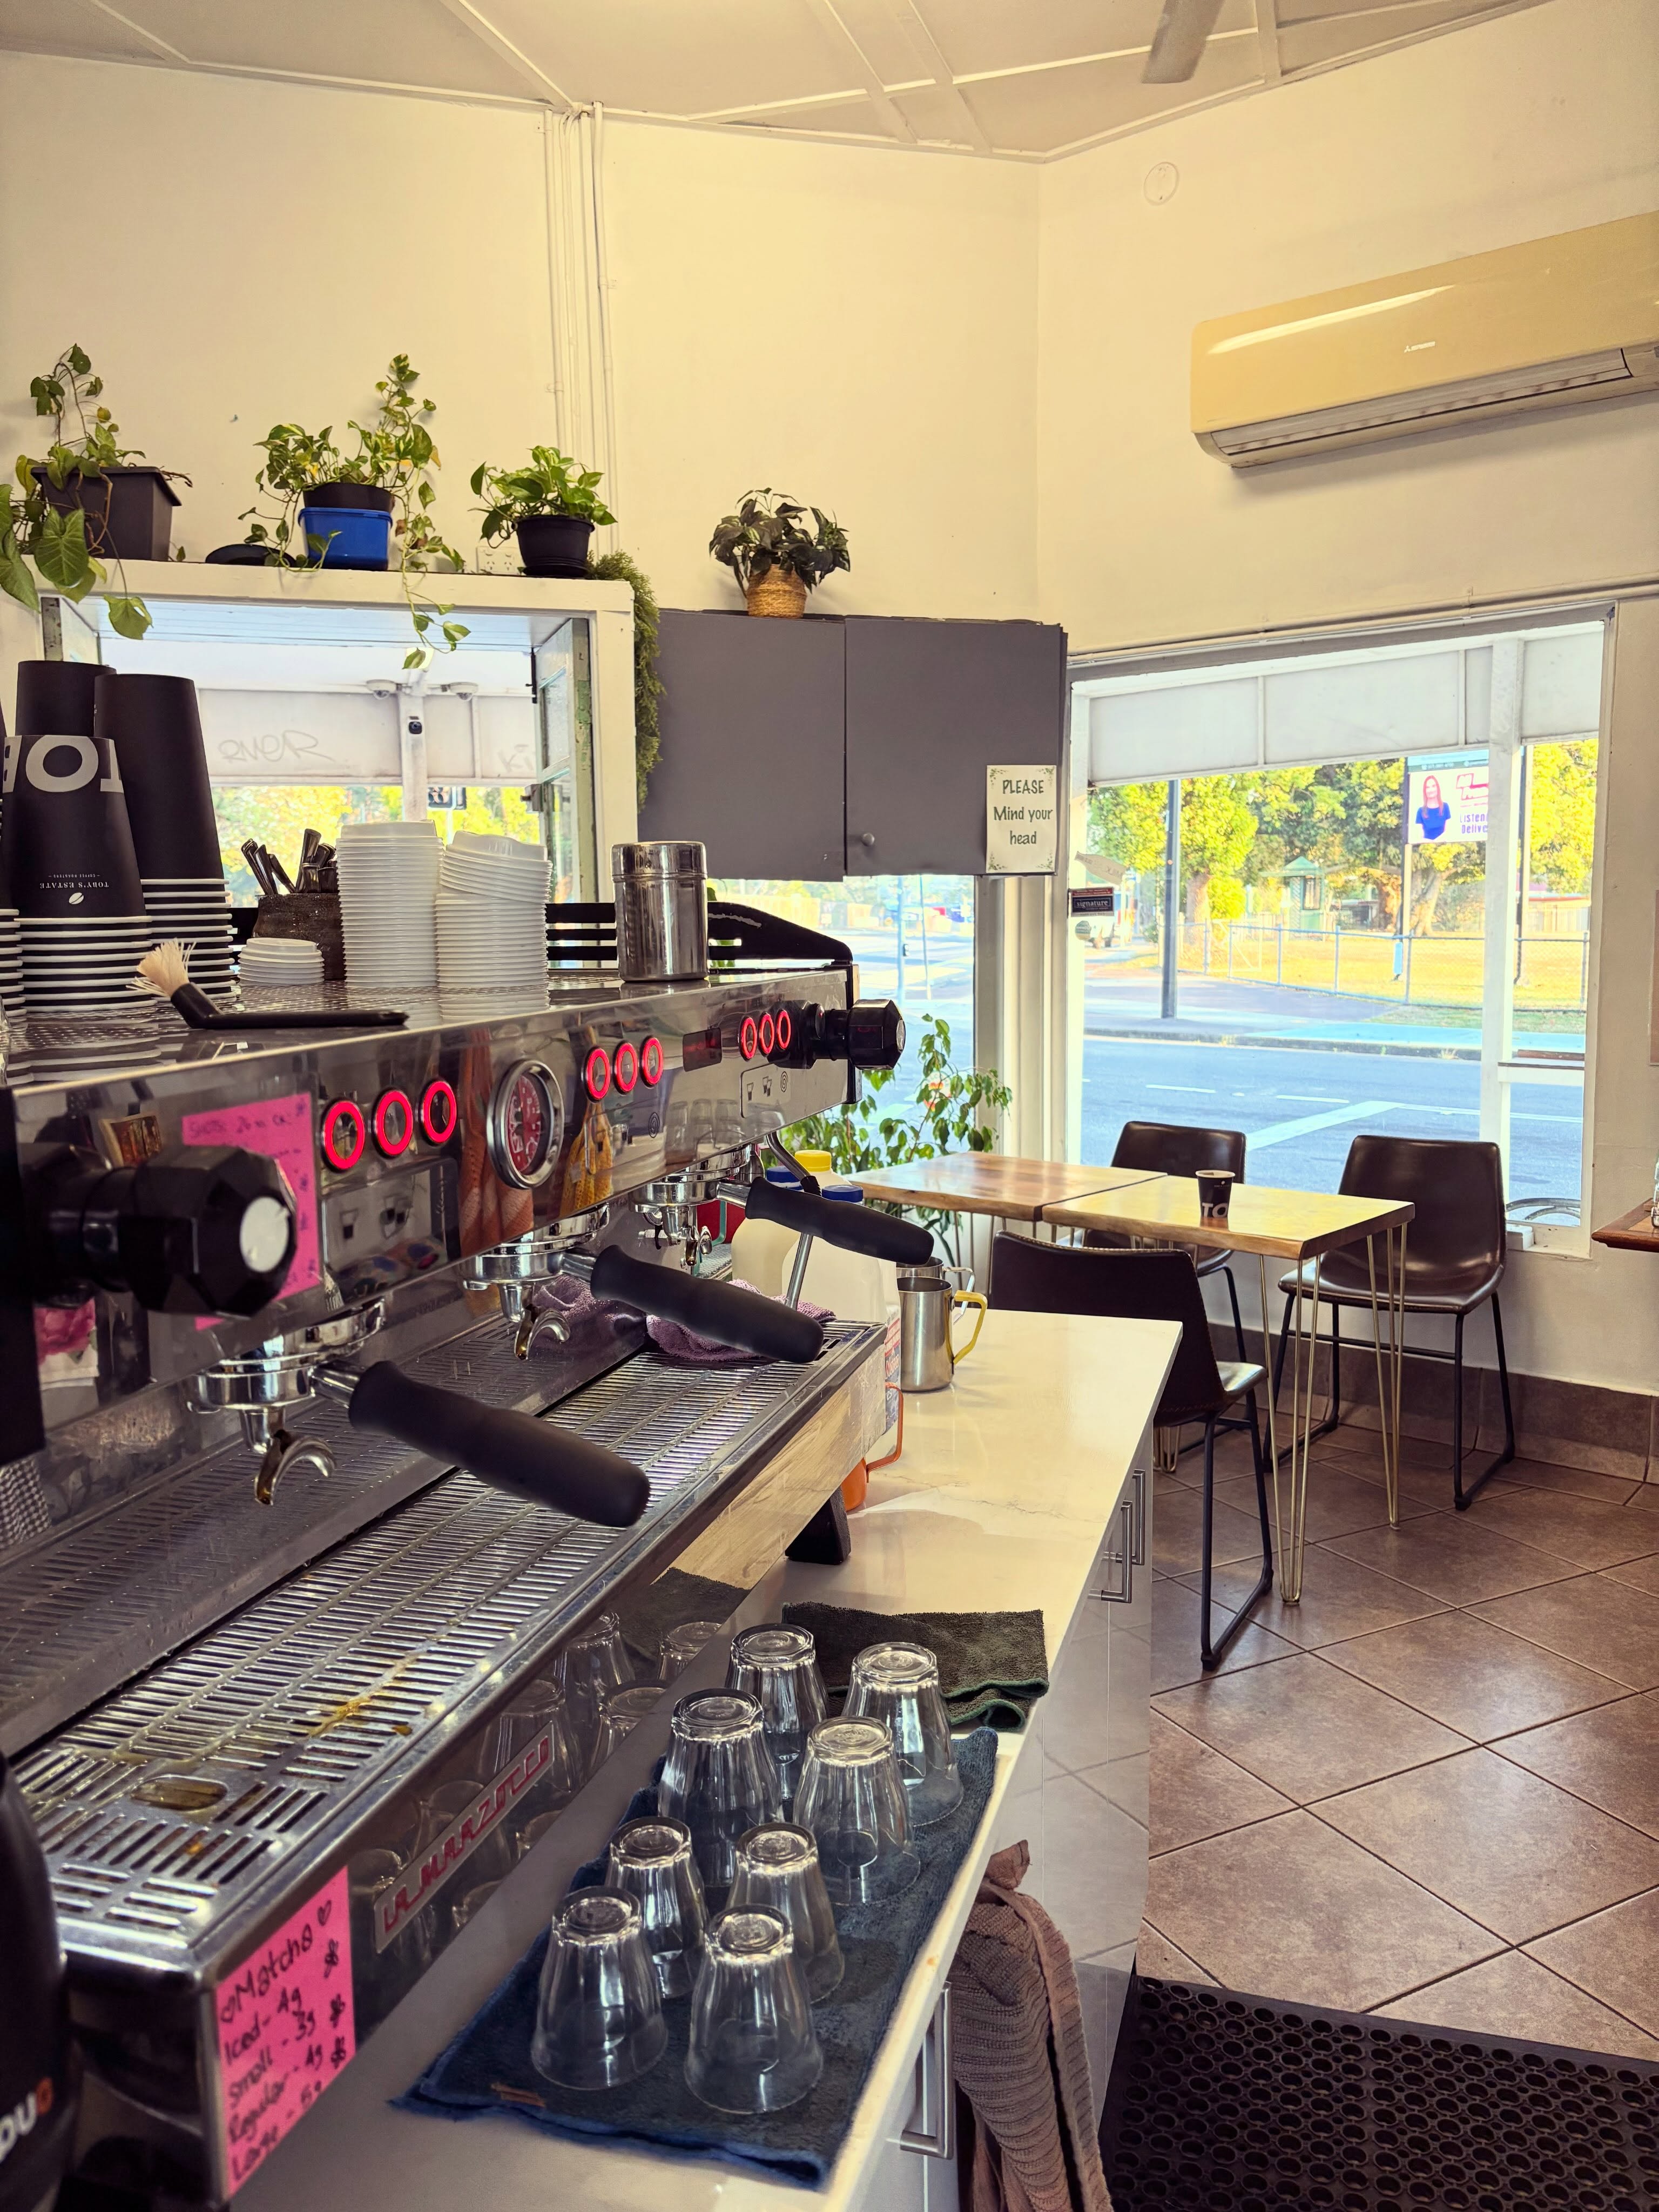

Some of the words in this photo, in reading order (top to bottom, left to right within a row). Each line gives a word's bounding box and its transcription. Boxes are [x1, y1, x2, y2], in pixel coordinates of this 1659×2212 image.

[1002, 779, 1044, 794] PLEASE
[994, 806, 1024, 820] Mind
[1028, 809, 1053, 822] your
[1010, 831, 1037, 845] head
